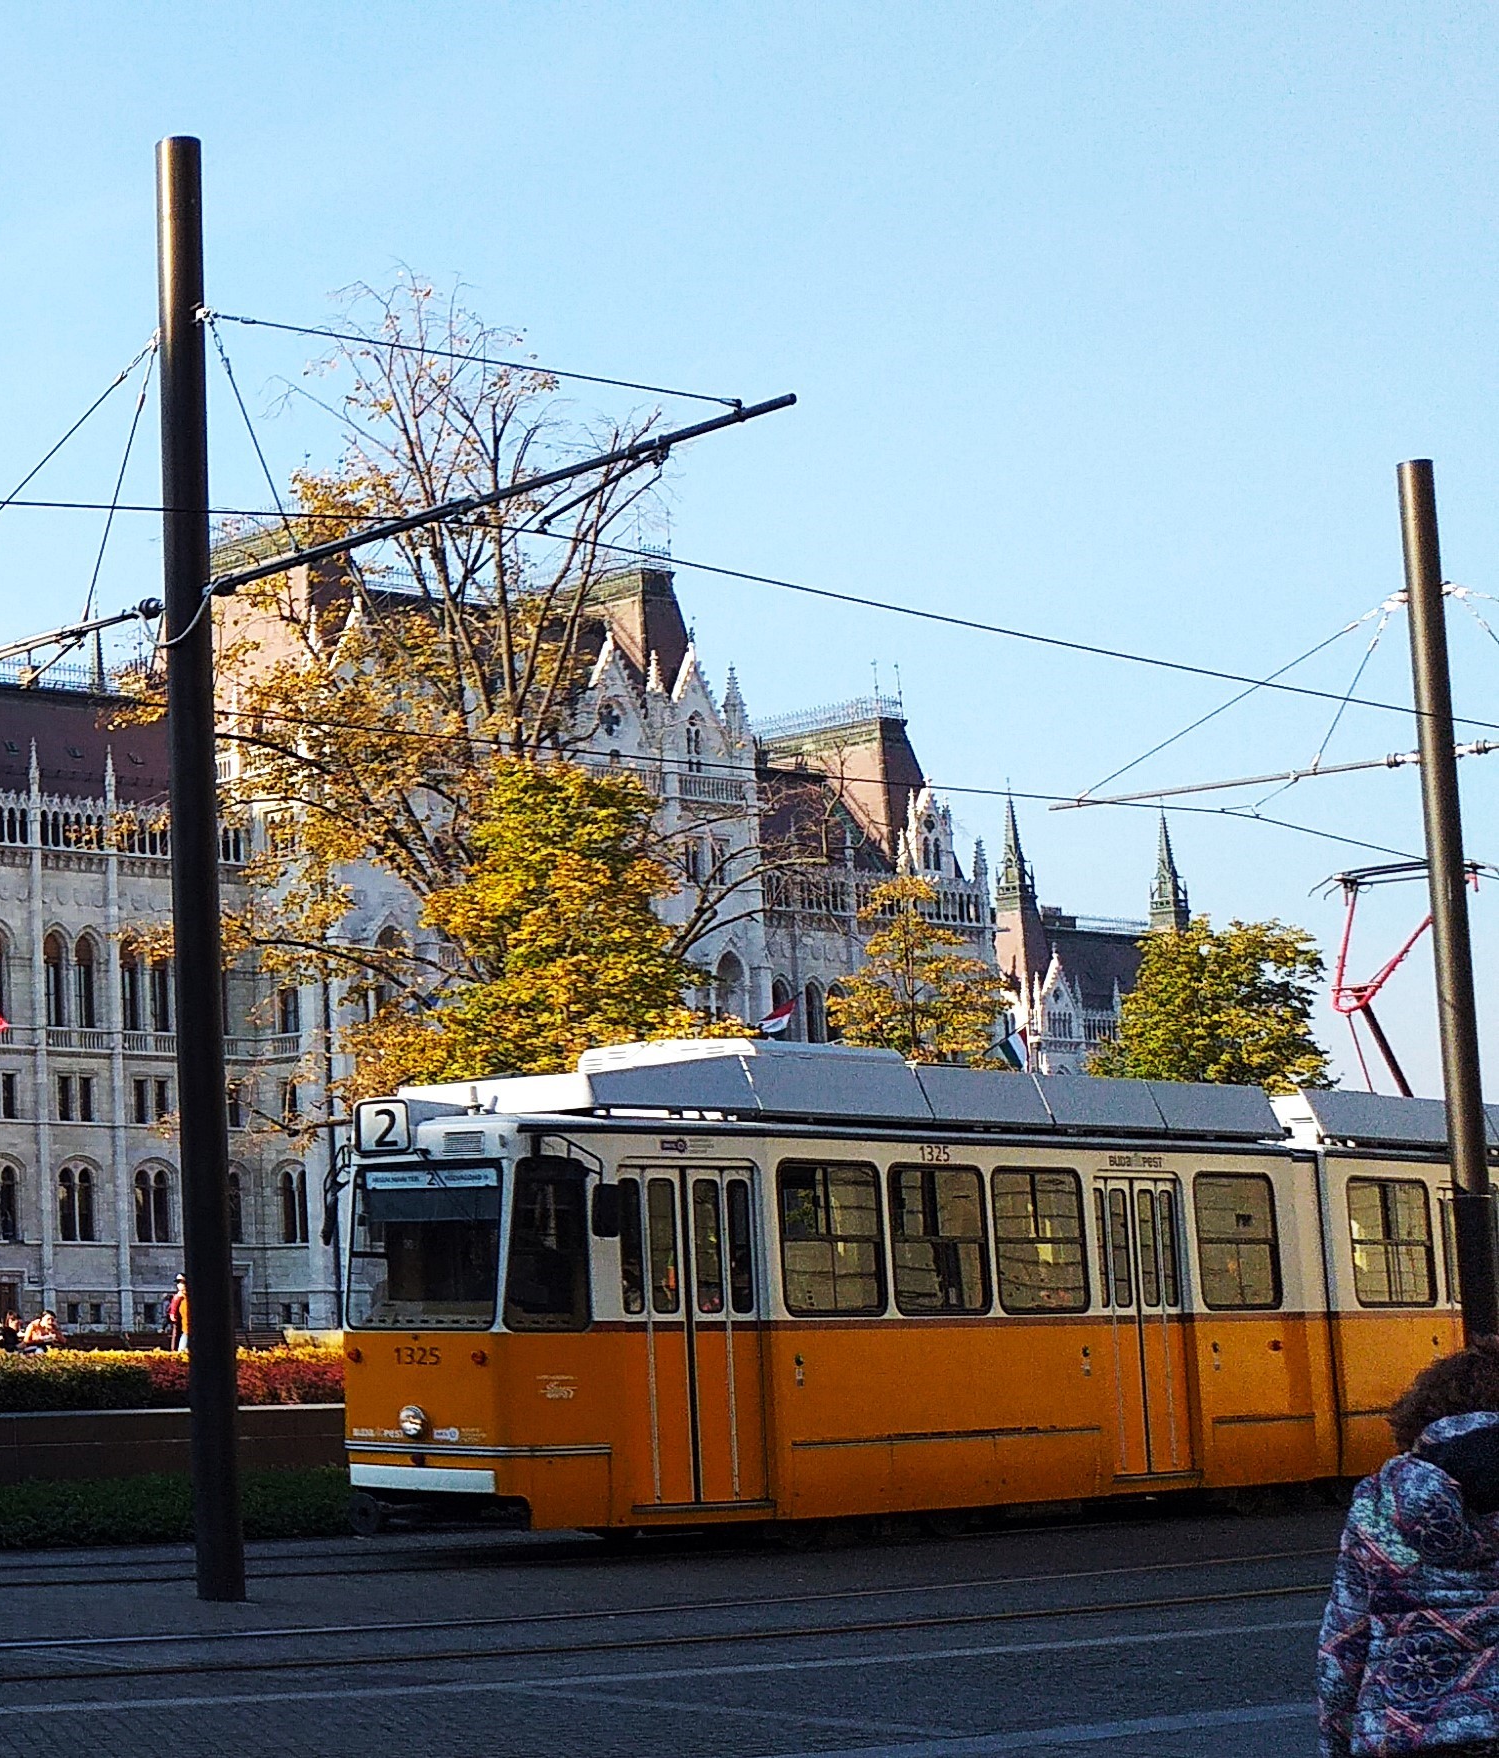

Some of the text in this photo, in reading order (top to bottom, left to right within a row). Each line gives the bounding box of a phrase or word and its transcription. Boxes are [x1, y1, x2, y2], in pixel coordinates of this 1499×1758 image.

[374, 1108, 398, 1147] 2
[919, 1145, 950, 1162] 1325
[426, 1171, 437, 1186] 2
[394, 1346, 440, 1365] 1325
